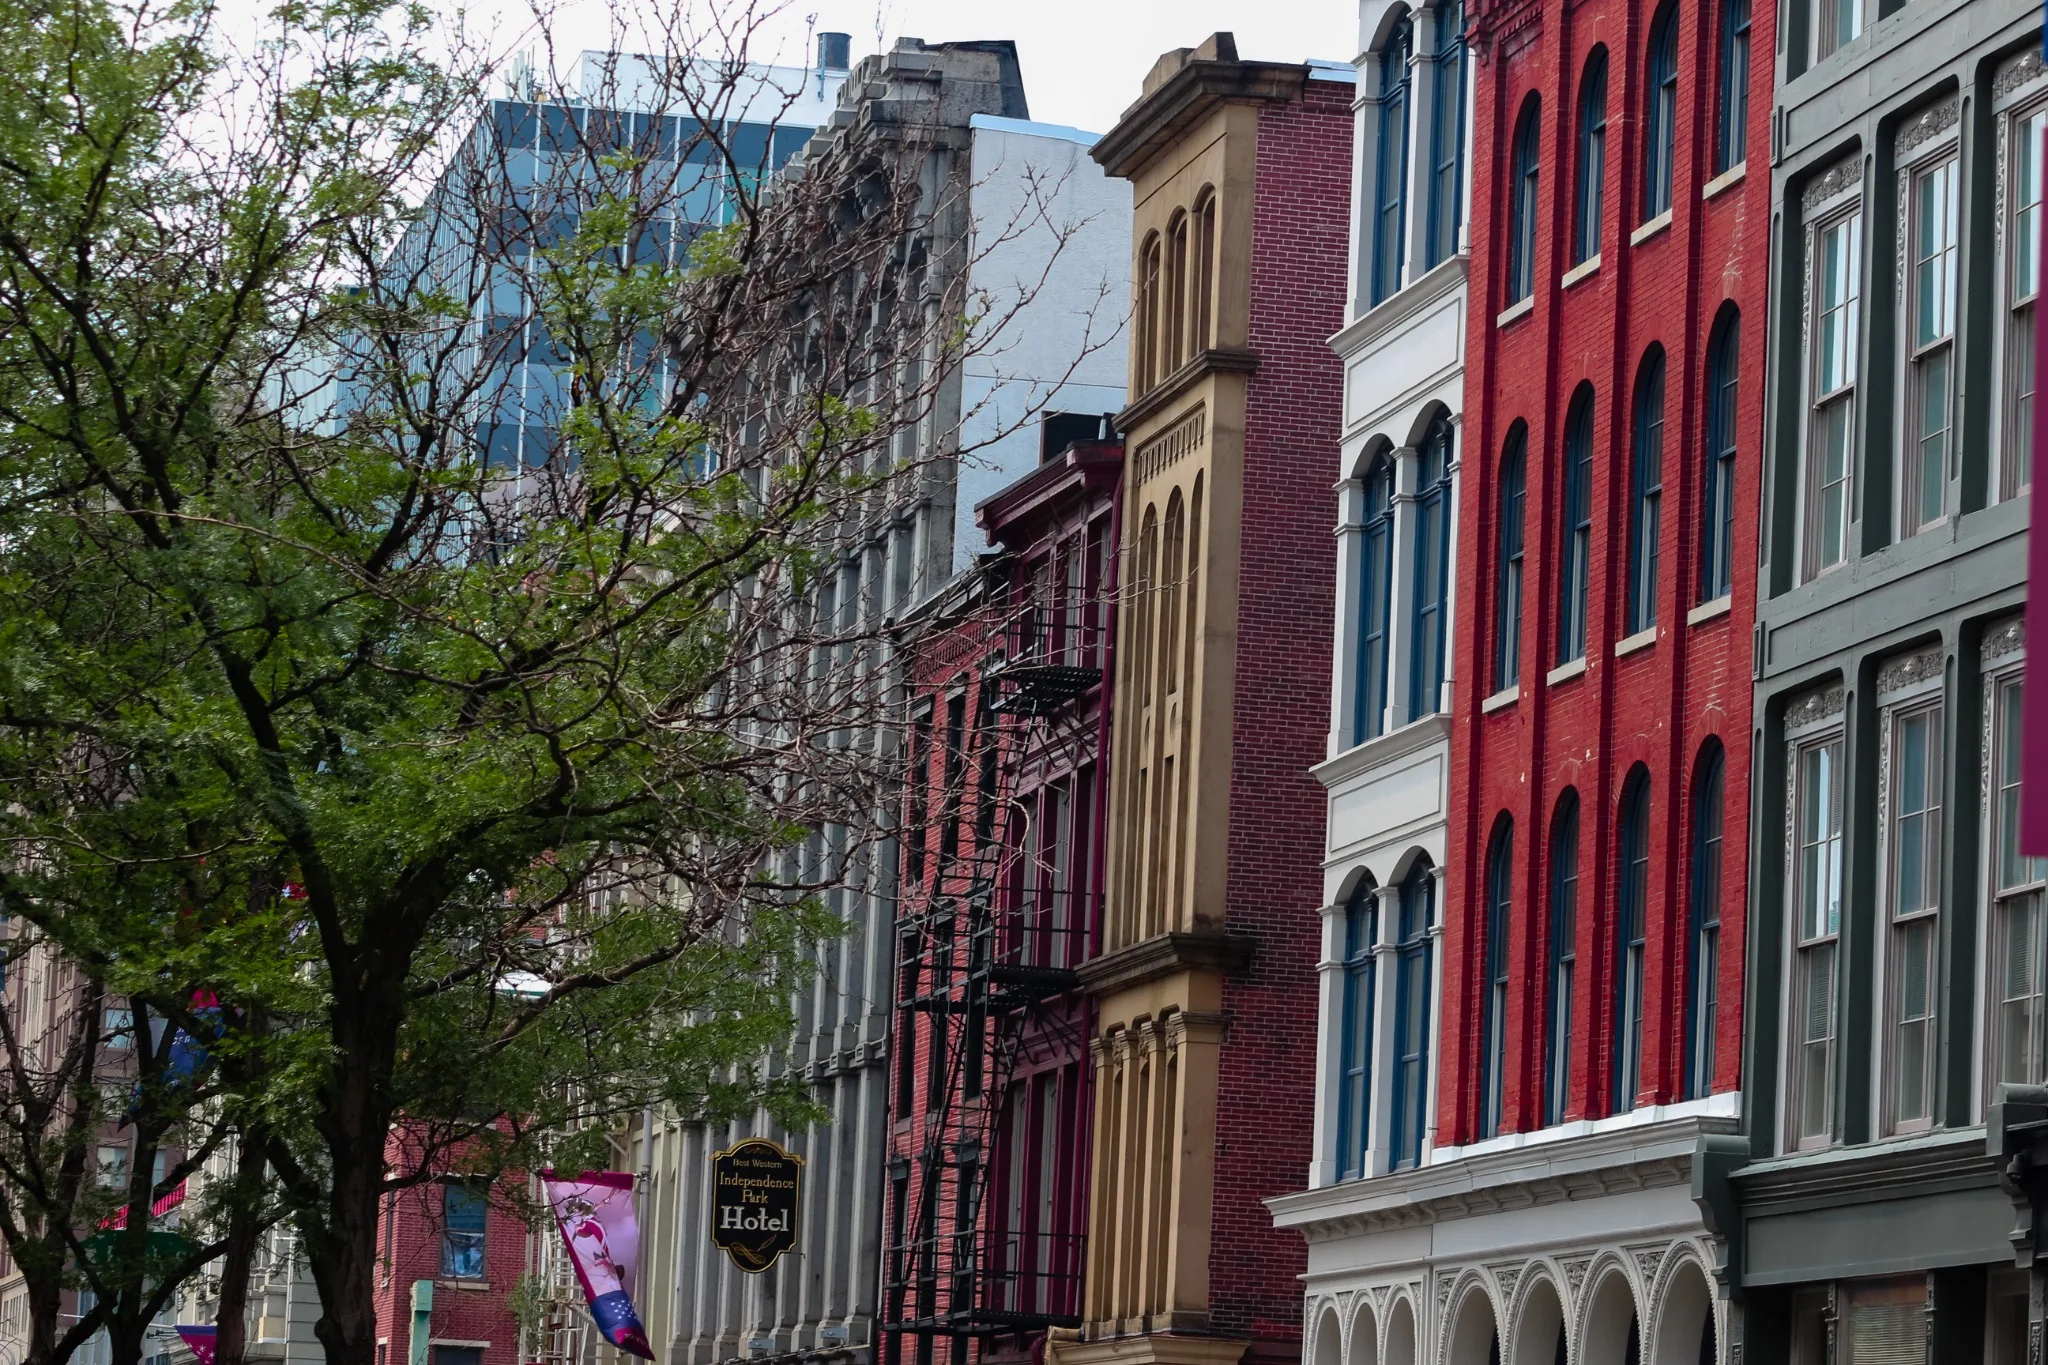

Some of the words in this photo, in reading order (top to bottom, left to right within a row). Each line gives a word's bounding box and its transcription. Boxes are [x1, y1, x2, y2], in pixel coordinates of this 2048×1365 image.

[733, 1158, 749, 1167] Best
[752, 1159, 782, 1168] Western
[720, 1172, 794, 1188] Independence
[742, 1189, 768, 1204] Park
[720, 1205, 789, 1231] Hotel
